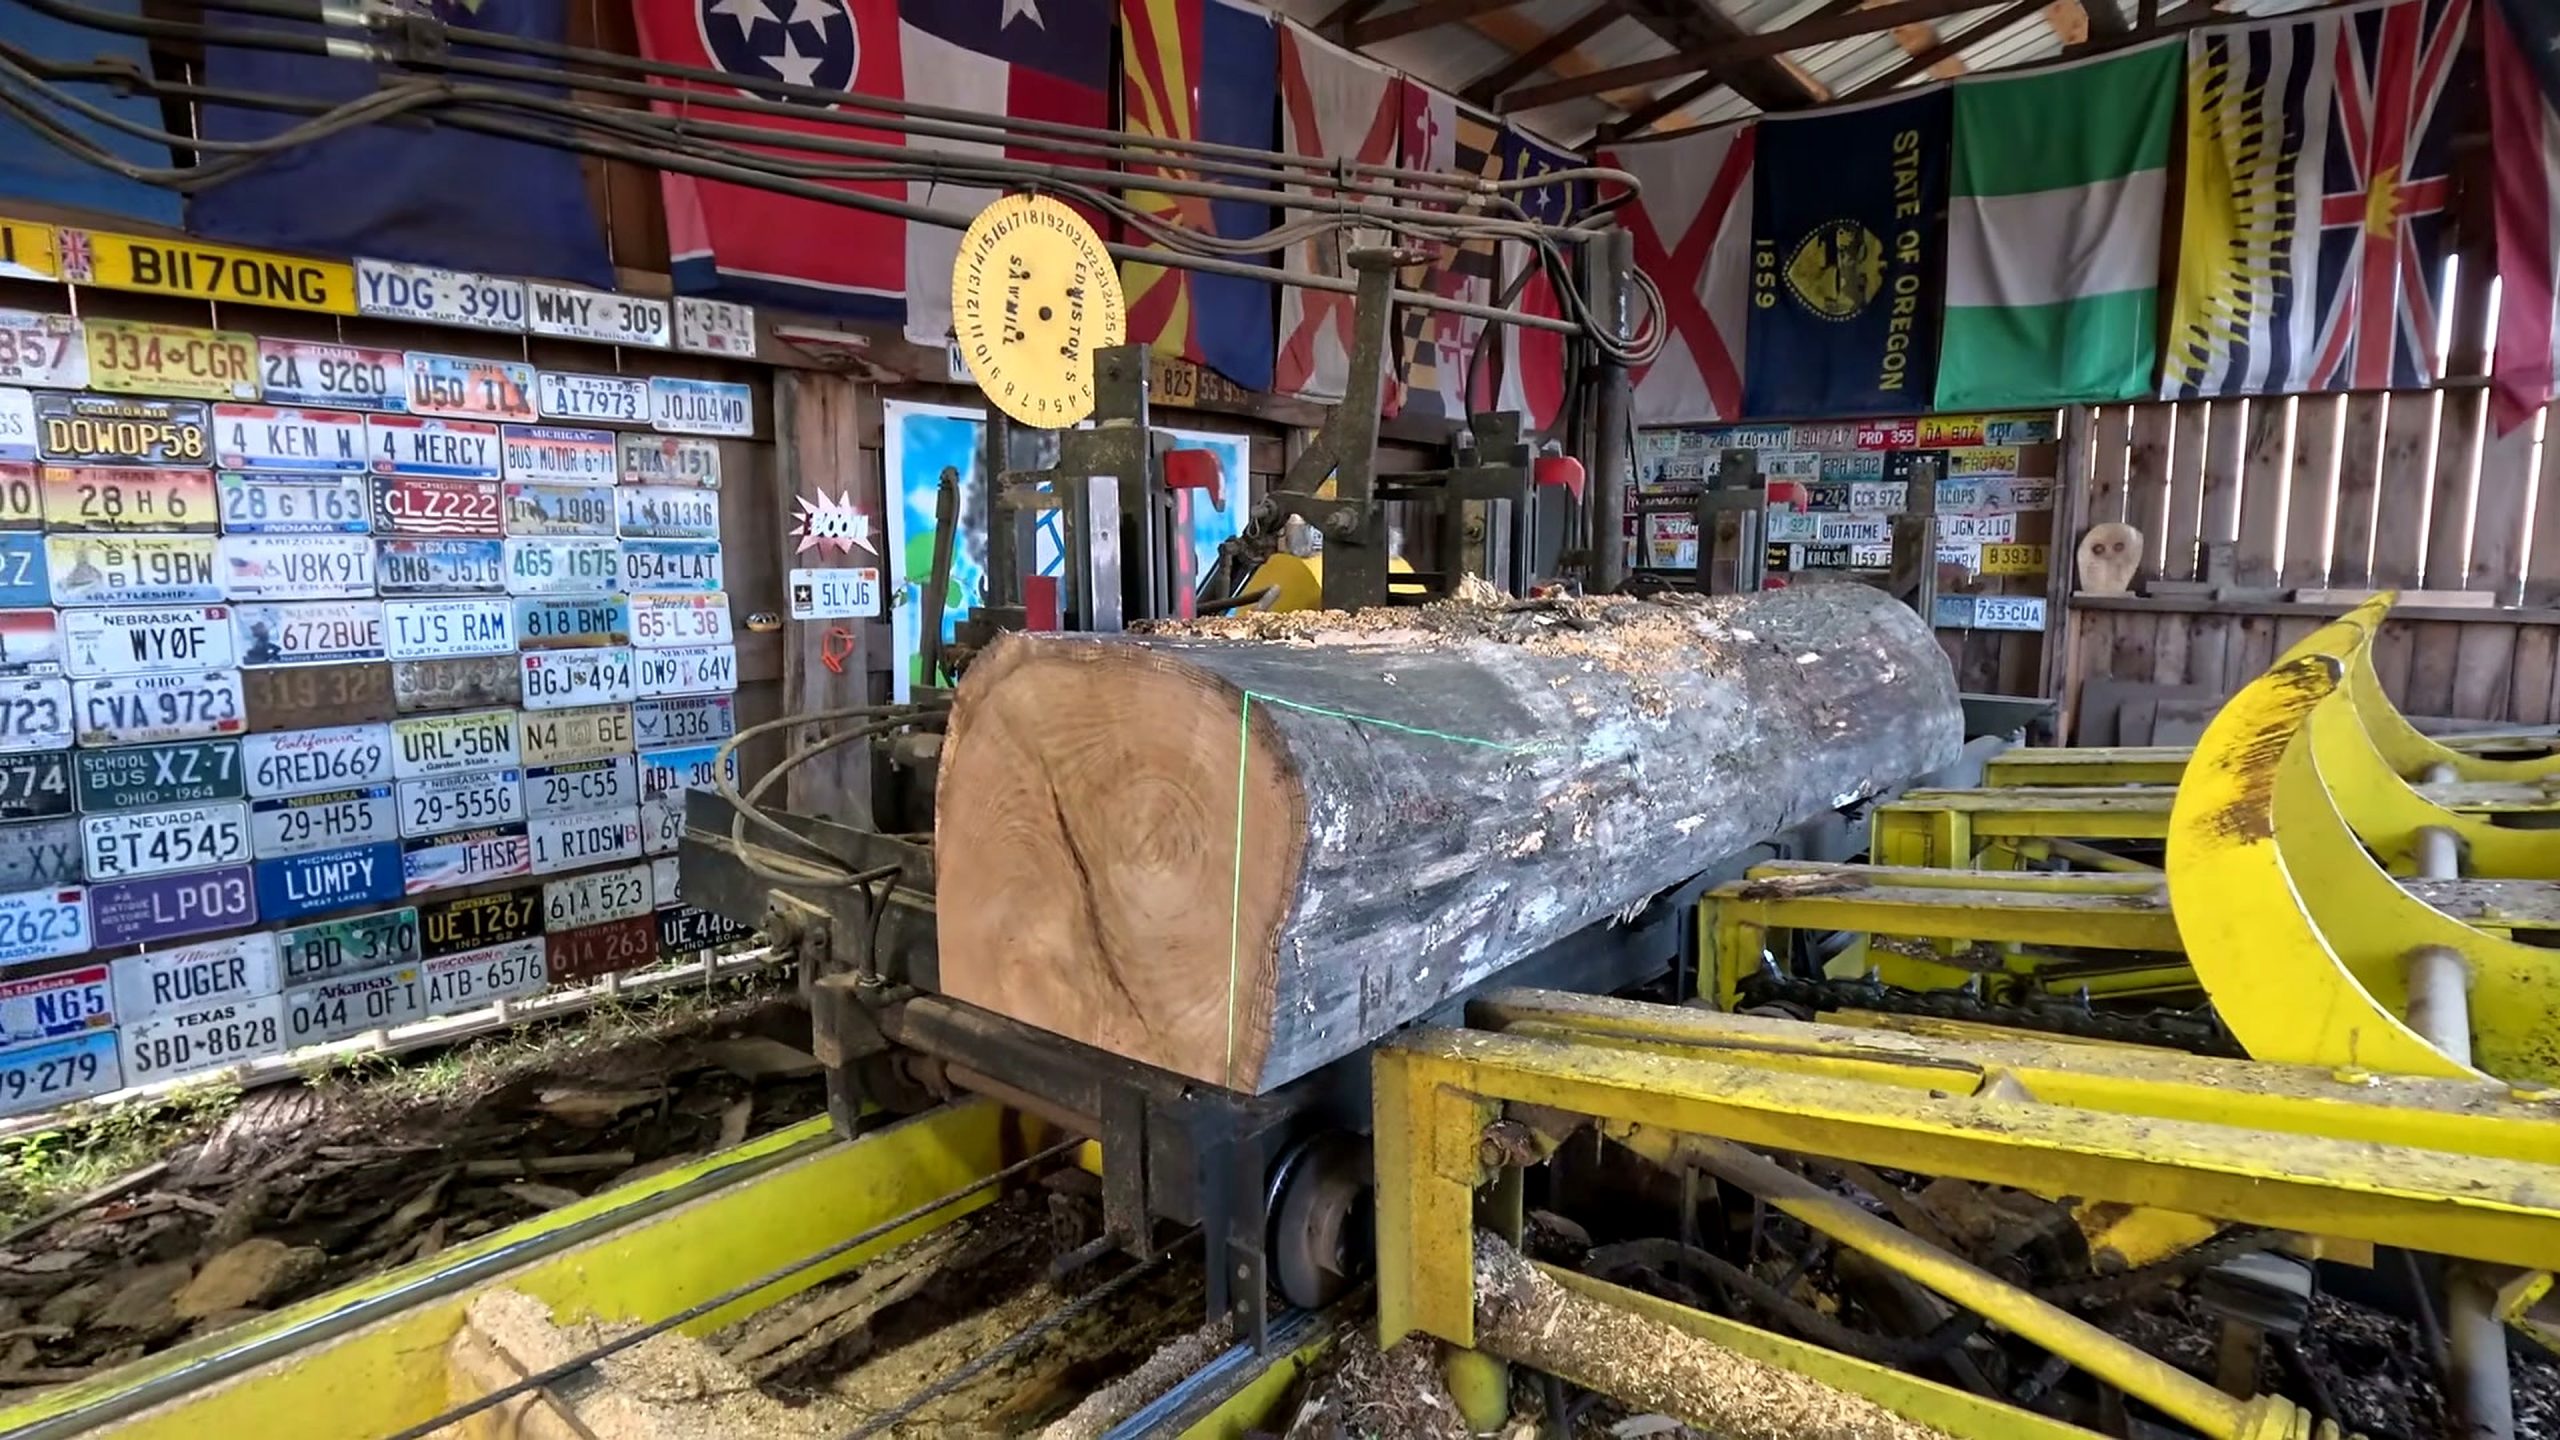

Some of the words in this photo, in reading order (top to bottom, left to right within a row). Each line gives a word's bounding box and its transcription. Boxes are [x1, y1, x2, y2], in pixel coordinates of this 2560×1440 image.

[1892, 129, 1920, 220] STATE
[1007, 212, 1020, 231] 17
[1022, 209, 1038, 225] 18
[1041, 211, 1055, 228] 19
[1055, 217, 1074, 238] 20
[1895, 230, 1920, 264] OF
[1755, 239, 1776, 309] 1859
[362, 269, 435, 310] YDG
[458, 283, 523, 322] 39U
[426, 312, 456, 321] HEART
[458, 314, 470, 322] OF
[473, 316, 489, 326] THE
[535, 291, 593, 327] WMY
[617, 302, 662, 335] 309
[1879, 276, 1919, 390] OREGON
[95, 330, 164, 374] 334
[187, 339, 249, 381] CGR
[451, 360, 494, 374] UTAH
[265, 354, 303, 389] 2A
[319, 358, 387, 395] 9260
[1163, 368, 1193, 398] 825
[76, 403, 168, 420] CALIFORNIA
[233, 422, 248, 454] 4
[267, 424, 320, 458] KEN
[336, 428, 354, 460] W
[531, 428, 589, 441] MICHIGAN
[1858, 430, 1884, 445] PRD
[1890, 429, 1915, 444] 355
[383, 431, 396, 460] 4
[413, 432, 486, 467] MERCY
[508, 443, 533, 470] BUS
[539, 445, 578, 473] MOTOR
[77, 484, 125, 518] 28
[136, 489, 153, 515] H
[167, 486, 188, 519] 6
[226, 486, 268, 520] 28
[278, 493, 294, 518] G
[308, 488, 363, 521] 163
[384, 488, 499, 519] CLZ222
[1824, 489, 1848, 506] 242
[1878, 489, 1902, 506] 972
[556, 497, 606, 525] 1989
[661, 502, 713, 528] 91336
[263, 523, 335, 533] INDIANA
[545, 525, 580, 535] TRUCK
[1821, 523, 1879, 539] OUTATIME
[1951, 519, 1975, 537] JGN
[264, 537, 337, 547] ARIZONA
[415, 541, 468, 554] TEXAS
[282, 552, 367, 584] V8K9T
[513, 548, 554, 578] 465
[567, 548, 618, 578] 1675
[626, 553, 665, 580] 054
[679, 554, 717, 580] LAT
[103, 612, 195, 627] NEBRASKA
[425, 603, 475, 612] WEIGHTED
[2011, 605, 2040, 622] CUA
[395, 614, 449, 646] TJ'S
[462, 612, 506, 642] RAM
[528, 611, 571, 636] 818
[577, 607, 619, 634] BMP
[283, 620, 384, 651] 672BUE
[397, 647, 441, 656] NORTH
[448, 644, 508, 653] CAROLINA
[135, 676, 185, 690] OHIO
[528, 666, 573, 697] BGJ
[588, 663, 631, 691] 494
[642, 658, 678, 686] DW9
[697, 656, 732, 684] 64V
[87, 693, 149, 733] CVA
[159, 688, 236, 726] 9723
[659, 699, 708, 711] ILLINOIS
[423, 718, 450, 730] New
[527, 720, 558, 751] N4
[663, 710, 710, 739] 1336
[275, 733, 363, 751] California
[403, 730, 454, 763] URL
[462, 724, 511, 756] 56N
[83, 754, 149, 772] SCHOOL
[152, 749, 203, 788] XZ
[257, 744, 382, 788] 6RED669
[426, 760, 463, 771] Garden
[463, 757, 490, 766] State
[553, 761, 609, 775] NEBRASKA
[91, 769, 147, 790] BUS
[431, 773, 490, 788] NEBRASKA
[544, 770, 618, 805] 29-C55
[114, 790, 159, 807] OHIO
[175, 785, 215, 801] 1964
[286, 789, 359, 809] NEBRASKA
[413, 786, 512, 827] 29-555G
[90, 819, 113, 835] 65
[129, 810, 206, 830] NEVADA
[277, 802, 373, 844] 29-H55
[433, 835, 465, 847] NEW
[466, 827, 499, 842] YORK
[535, 835, 549, 863] 1
[296, 850, 364, 867] MICHIGAN
[457, 840, 519, 875] JFHSR
[285, 857, 375, 901] LUMPY
[602, 873, 626, 884] YEAR
[101, 899, 150, 915] ANTIQUE
[301, 897, 332, 908] GREAT
[337, 891, 369, 903] LAKES
[600, 879, 643, 910] 523
[101, 910, 150, 926] HISTORIC
[116, 922, 140, 933] CAR
[427, 912, 463, 943] UE
[471, 897, 535, 936] 1267
[573, 923, 627, 938] INDIANA
[455, 937, 481, 950] IND
[664, 918, 691, 946] UE
[683, 939, 704, 951] IND
[285, 936, 343, 977] LBD
[361, 922, 414, 960] 370
[605, 929, 648, 962] 263
[426, 950, 494, 972] WISCONSIN
[152, 956, 247, 1005] RUGER
[316, 976, 393, 1001] Arkansas
[430, 954, 542, 1004] ATB-6576
[34, 983, 104, 1025] N65
[174, 1005, 236, 1028] TEXAS
[293, 998, 348, 1035] 044
[135, 1034, 191, 1073] SBD
[207, 1016, 277, 1056] 8628
